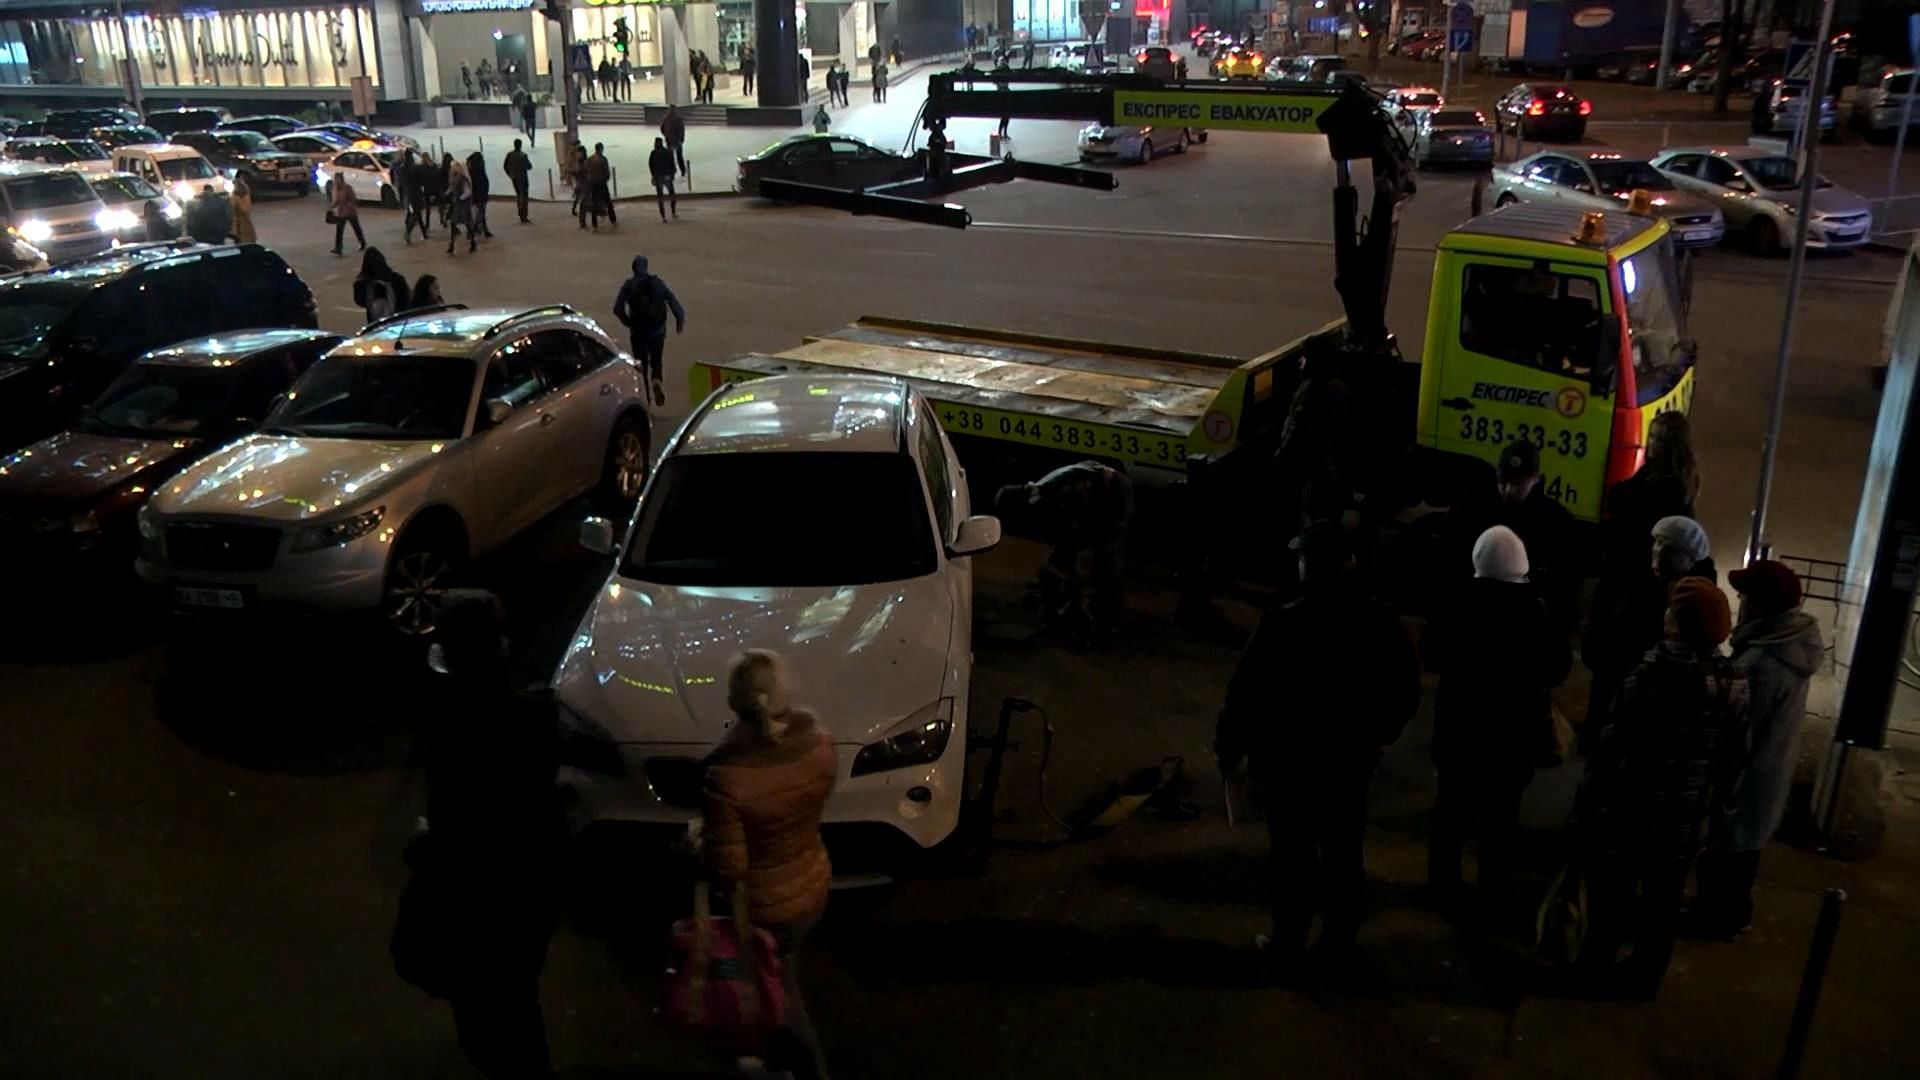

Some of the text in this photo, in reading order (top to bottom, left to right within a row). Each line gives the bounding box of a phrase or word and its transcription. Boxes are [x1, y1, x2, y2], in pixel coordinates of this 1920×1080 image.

[1123, 102, 1314, 123] ЕКСПРЕС ЕВАКУАТОР
[1472, 382, 1550, 407] ЕКСПРЕС
[943, 409, 985, 431] +38
[999, 416, 1042, 440] 044
[1051, 423, 1187, 463] 383-33-33
[1460, 414, 1588, 459] 383-33-33
[1540, 474, 1577, 505] 4h
